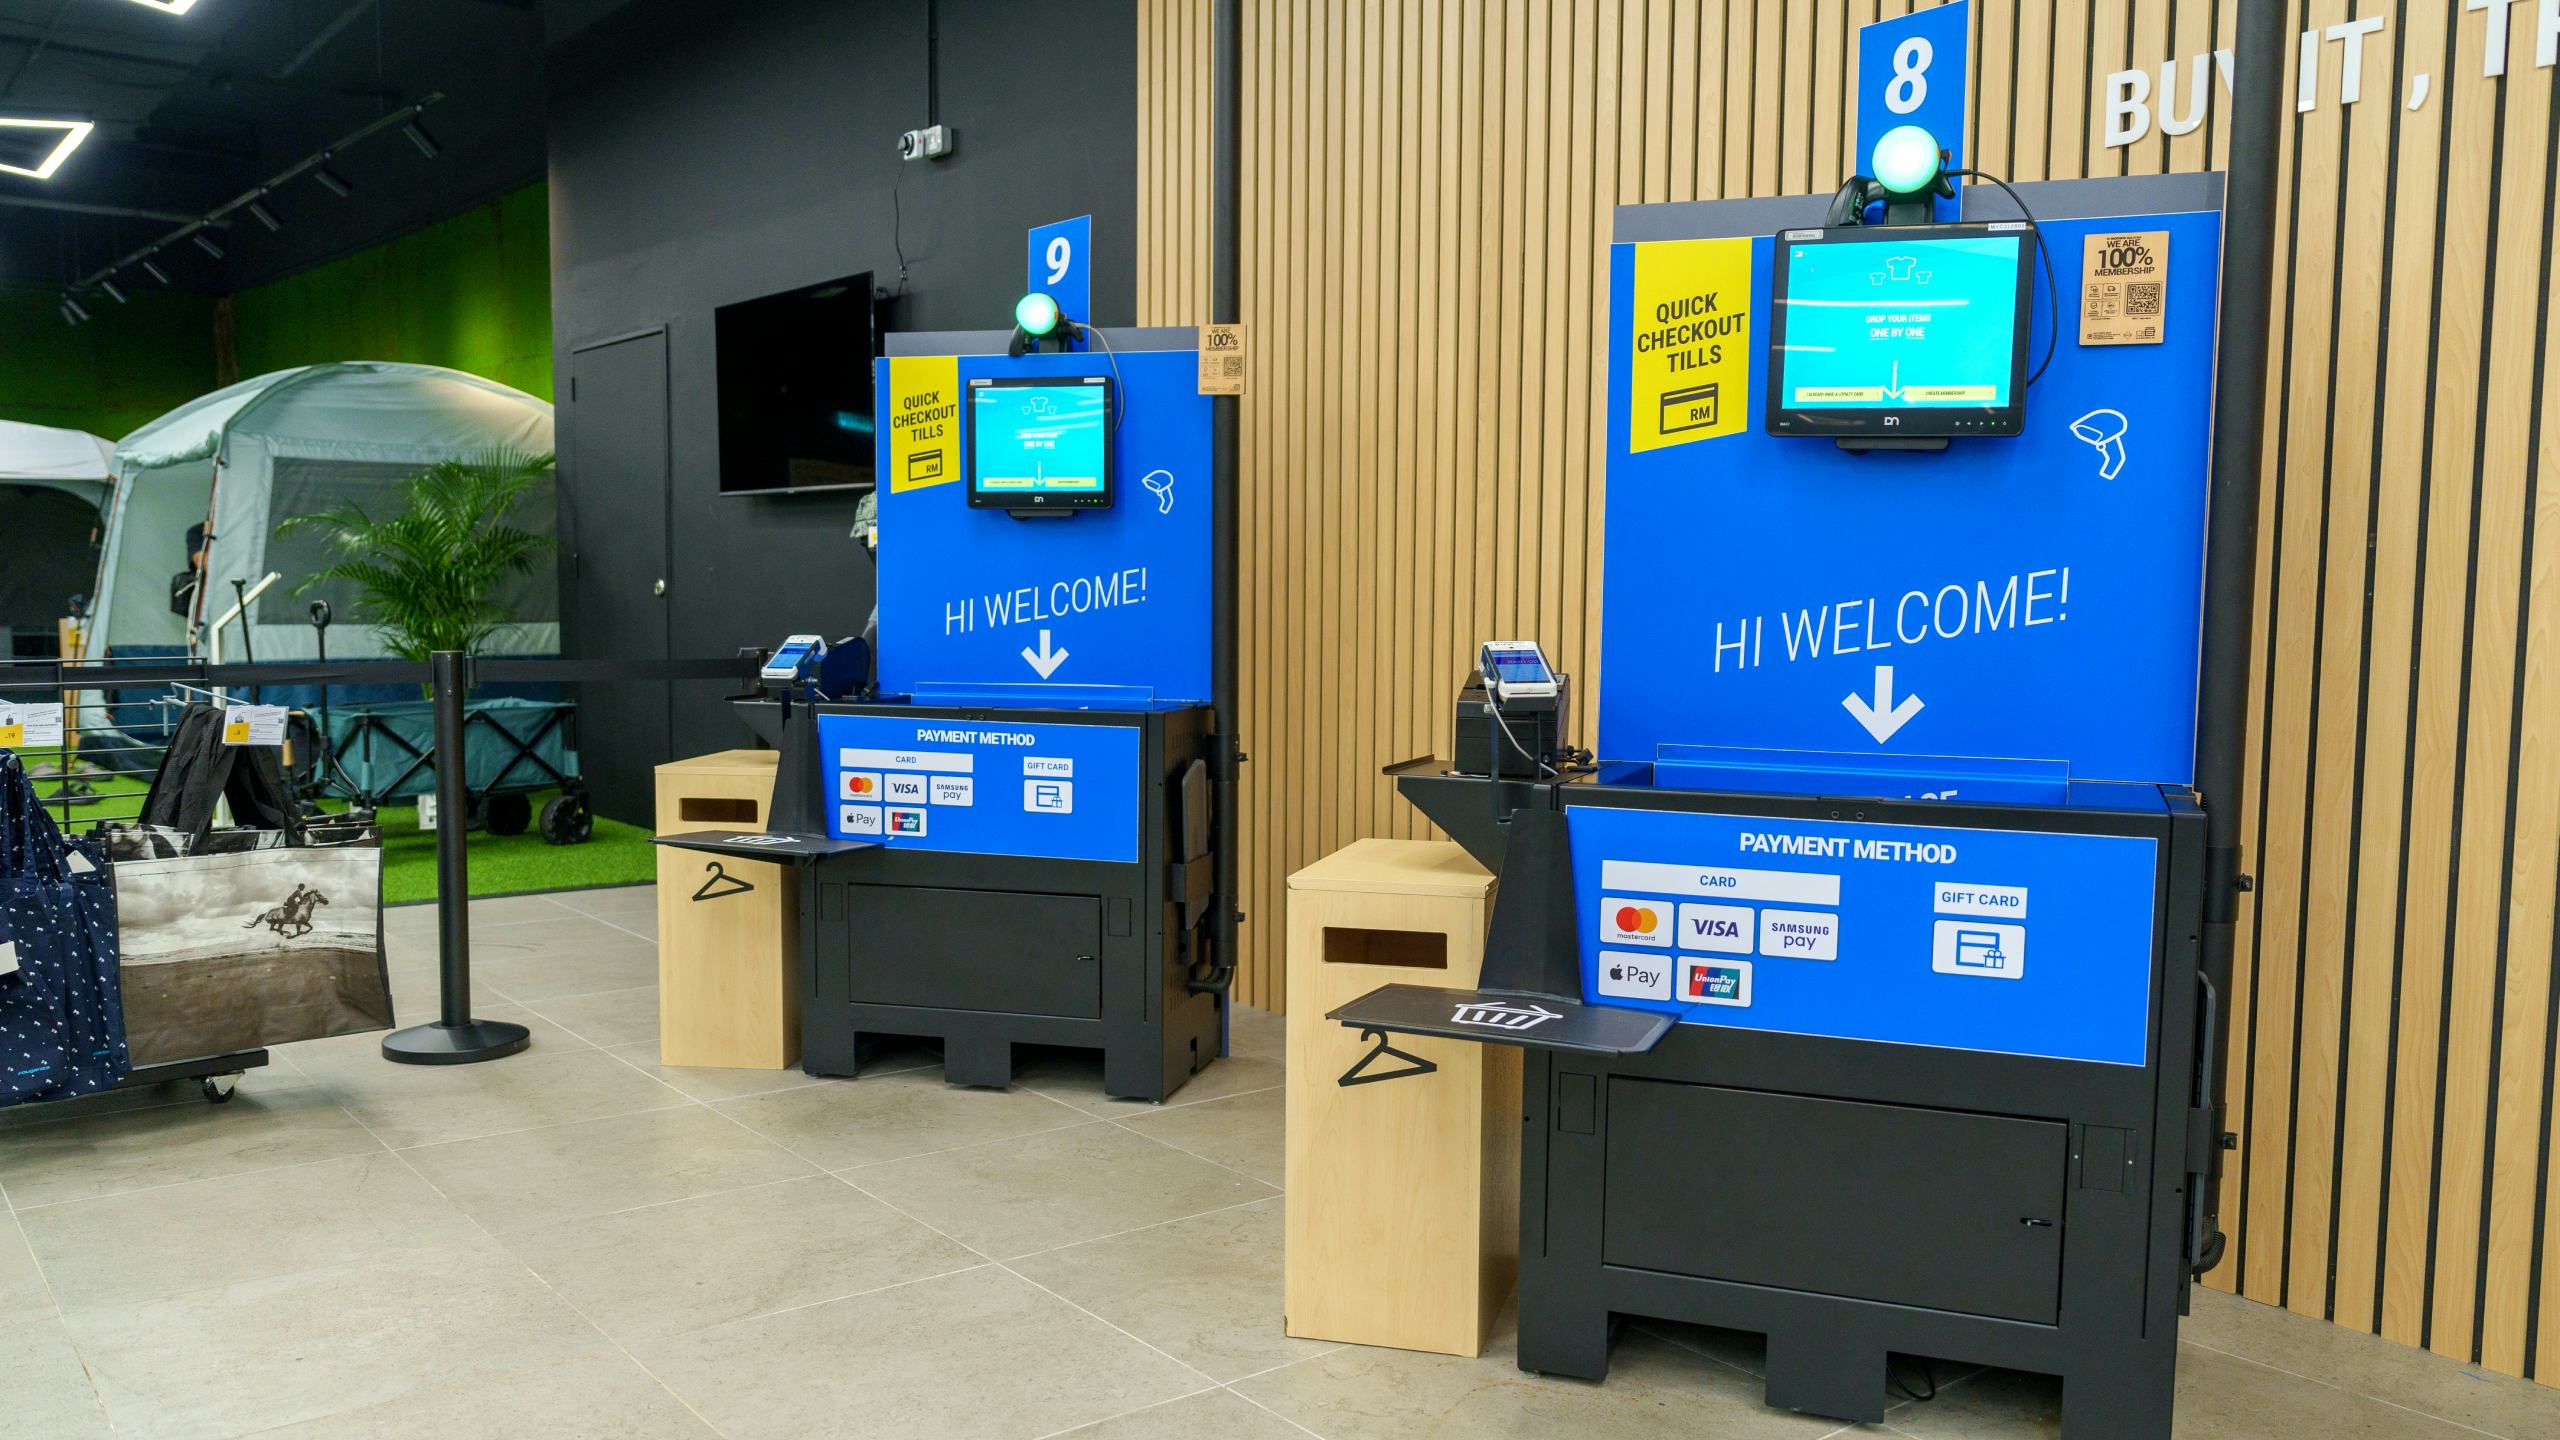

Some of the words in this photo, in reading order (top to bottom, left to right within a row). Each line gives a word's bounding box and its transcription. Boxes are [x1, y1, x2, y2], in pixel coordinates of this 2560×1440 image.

[1884, 37, 1933, 115] 8
[2107, 240, 2120, 248] WE
[2122, 239, 2140, 247] ARE
[1046, 236, 1071, 285] 9
[2098, 247, 2153, 268] 100%
[2095, 267, 2155, 276] MEMBERSHIP
[1656, 292, 1718, 324] QUICK
[1208, 333, 1238, 346] 100%
[1637, 313, 1746, 353] CHECKOUT
[1870, 328, 1889, 337] ONE
[1891, 327, 1904, 337] BY
[1905, 327, 1925, 337] ONE
[1667, 345, 1721, 373] TILLS
[904, 391, 939, 410] QUICK
[893, 404, 956, 429] CHECKOUT
[1690, 406, 1711, 423] RM
[911, 424, 943, 442] TILLS
[926, 463, 938, 473] RM
[945, 598, 974, 636] HI
[984, 567, 1148, 627] WELCOME!
[1715, 616, 1762, 673] HI
[1781, 567, 2070, 662] WELCOME!
[917, 729, 977, 745] PAYMENT
[979, 731, 1035, 746] METHOD
[895, 755, 917, 765] CARD
[1027, 762, 1046, 771] GIFT
[1047, 763, 1069, 772] CARD
[892, 783, 919, 794] VISA
[943, 791, 962, 800] pay
[856, 813, 876, 827] Pay
[1740, 832, 1849, 858] PAYMENT
[1854, 838, 1956, 864] METHOD
[1700, 875, 1736, 888] CARD
[1941, 891, 1975, 904] GIFT
[1978, 893, 2019, 907] CARD
[1691, 918, 1739, 938] VISA
[1771, 922, 1830, 936] SAMSUNG
[1617, 933, 1656, 942] mastercard
[1784, 933, 1816, 950] pay
[1627, 966, 1660, 988] Pay
[1695, 973, 1736, 987] UnionPay
